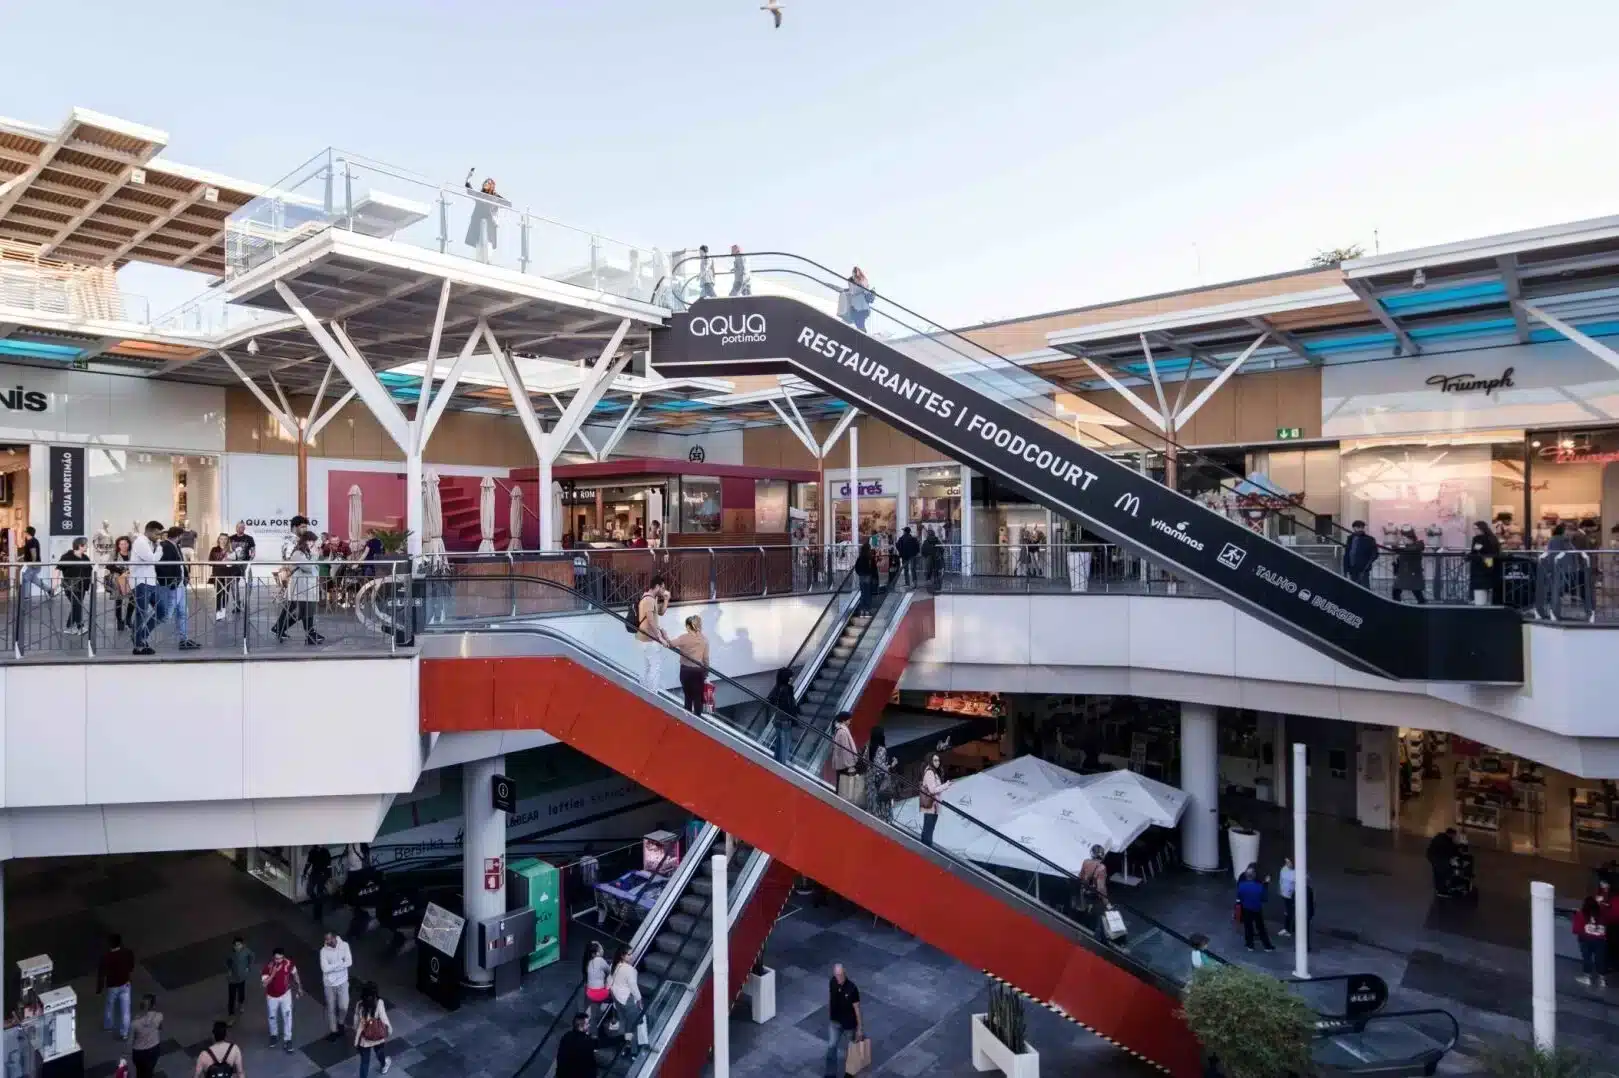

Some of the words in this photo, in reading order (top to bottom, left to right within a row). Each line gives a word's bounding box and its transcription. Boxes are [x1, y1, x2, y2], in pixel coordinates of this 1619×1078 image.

[690, 313, 766, 336] aqua
[721, 333, 767, 346] portimão
[1425, 366, 1514, 396] Triumph
[797, 326, 952, 418] RESTAURANTES
[967, 414, 1098, 491] FOODCOURT
[62, 452, 72, 493] PORTIMÃO
[63, 495, 72, 517] AQUA
[1151, 517, 1205, 551] vitaminas
[1255, 565, 1298, 594] TALHO
[1311, 594, 1364, 629] BURGER
